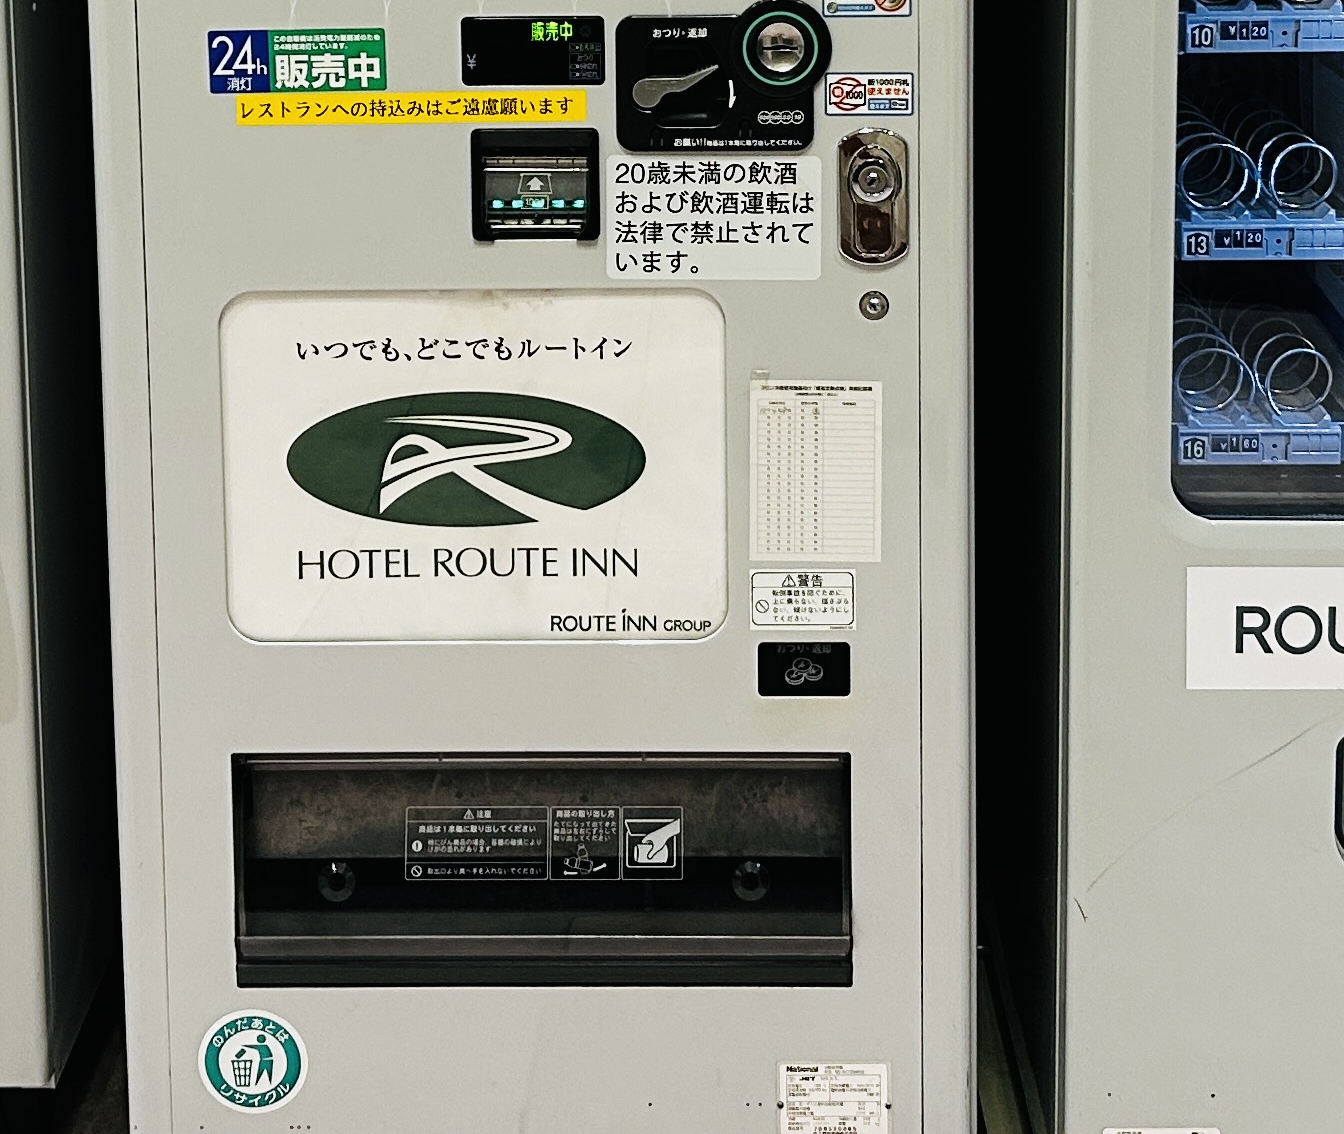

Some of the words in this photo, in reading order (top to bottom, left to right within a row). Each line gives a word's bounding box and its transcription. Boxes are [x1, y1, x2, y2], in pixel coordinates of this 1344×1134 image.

[531, 22, 573, 41] 販売中
[1193, 28, 1211, 45] 10
[275, 54, 380, 88] 販売中
[227, 77, 253, 91] 消灯
[868, 88, 909, 96] 使えません
[241, 97, 574, 119] レストランへの持込みはご遠慮願います
[616, 162, 796, 185] 20歳未満の飲酒
[616, 192, 813, 215] および飲酒運転は
[615, 221, 811, 245] 法律で禁止されて
[1189, 235, 1206, 253] 13
[615, 252, 700, 273] います。
[296, 337, 632, 362] いつでも、どこでもルートイン
[1186, 439, 1202, 457] 16
[298, 548, 420, 580] HOTEL
[434, 547, 558, 578] ROUTE
[572, 547, 638, 577] INN
[798, 574, 823, 587] 警告
[551, 615, 616, 632] ROUTE
[664, 620, 712, 632] GROUP
[213, 1018, 289, 1047] のんだあとは
[220, 1083, 289, 1106] リサイクル
